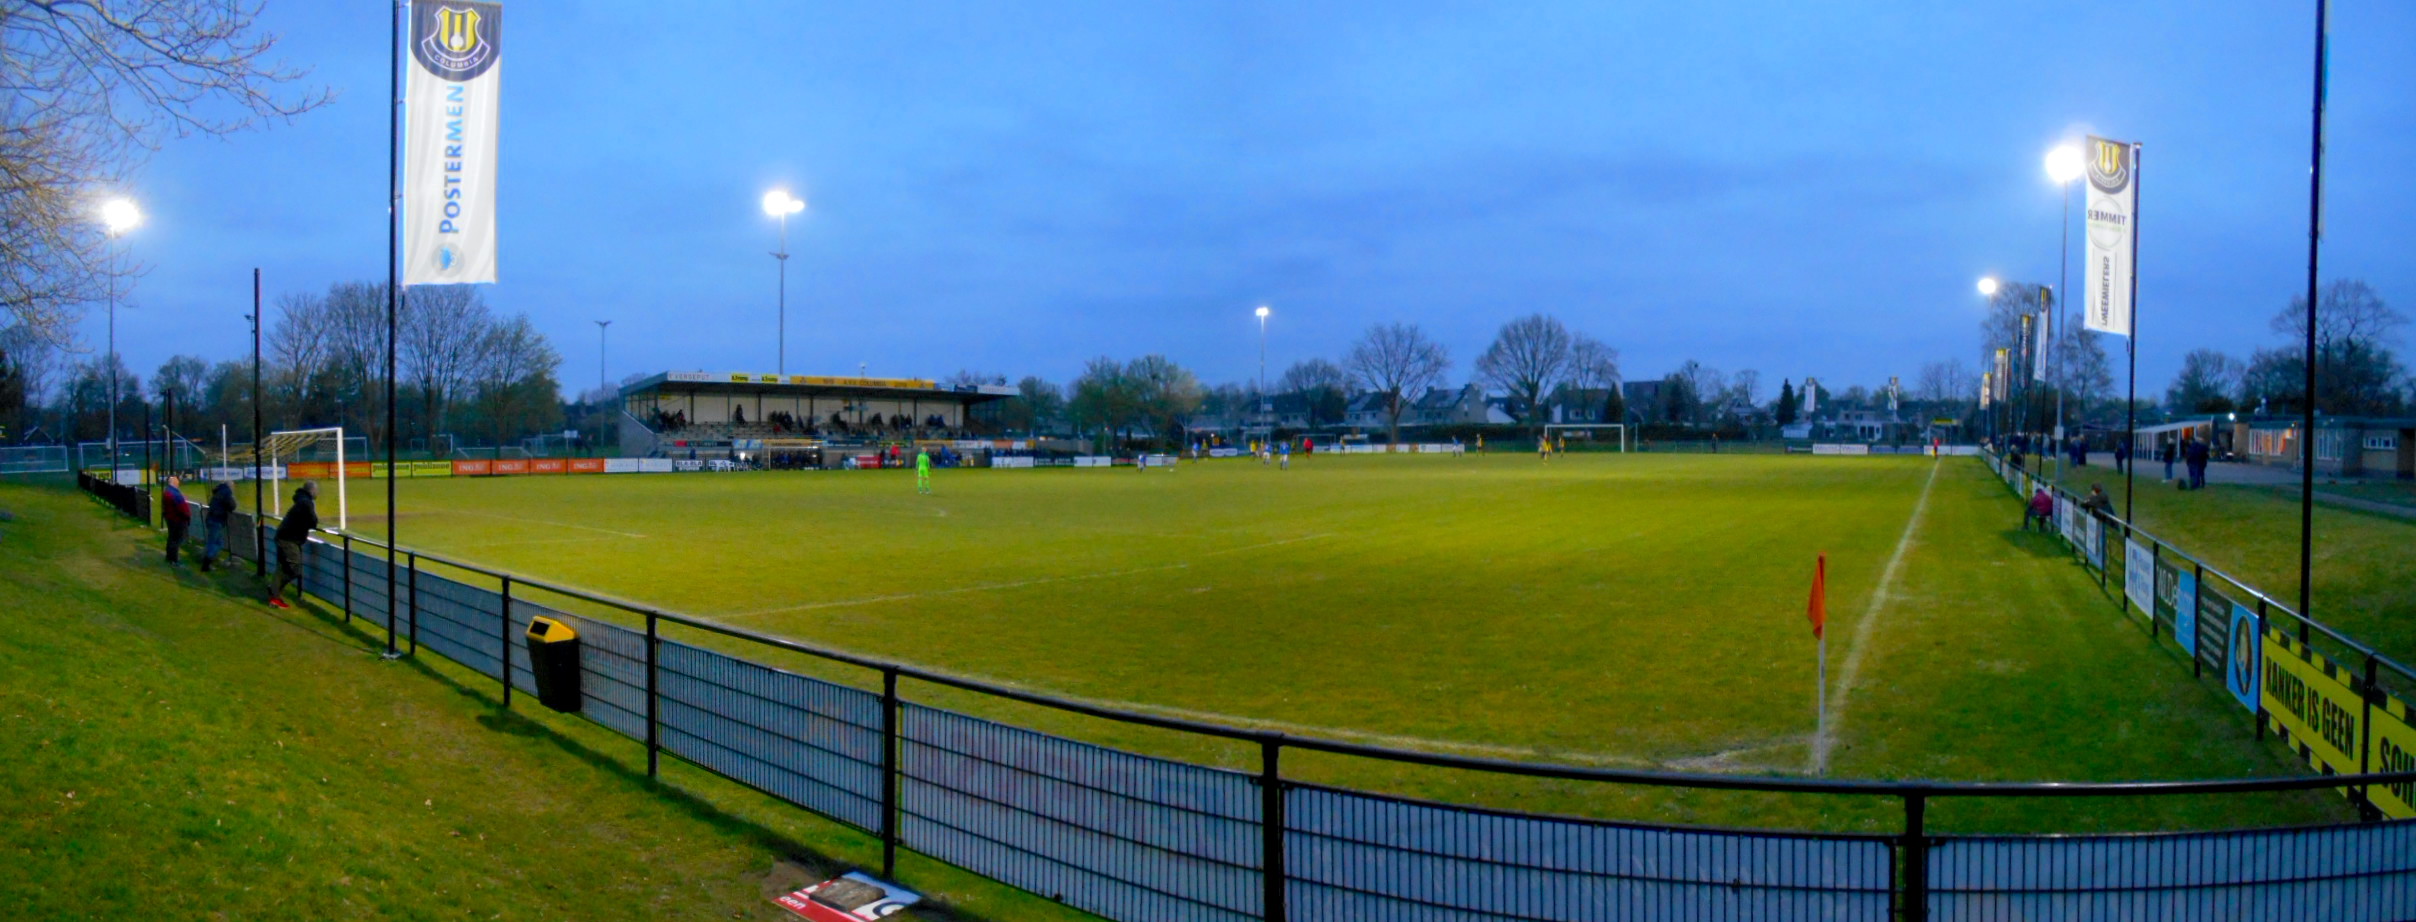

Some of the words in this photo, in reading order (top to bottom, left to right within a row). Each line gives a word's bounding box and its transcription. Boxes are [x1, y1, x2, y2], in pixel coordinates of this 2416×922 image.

[434, 54, 479, 69] COLUMBIA
[438, 84, 465, 234] POSTERMEN
[2265, 655, 2305, 722] KANKER
[2307, 686, 2320, 733] IS
[2322, 697, 2355, 761] GEEN
[2380, 735, 2416, 813] SCH
